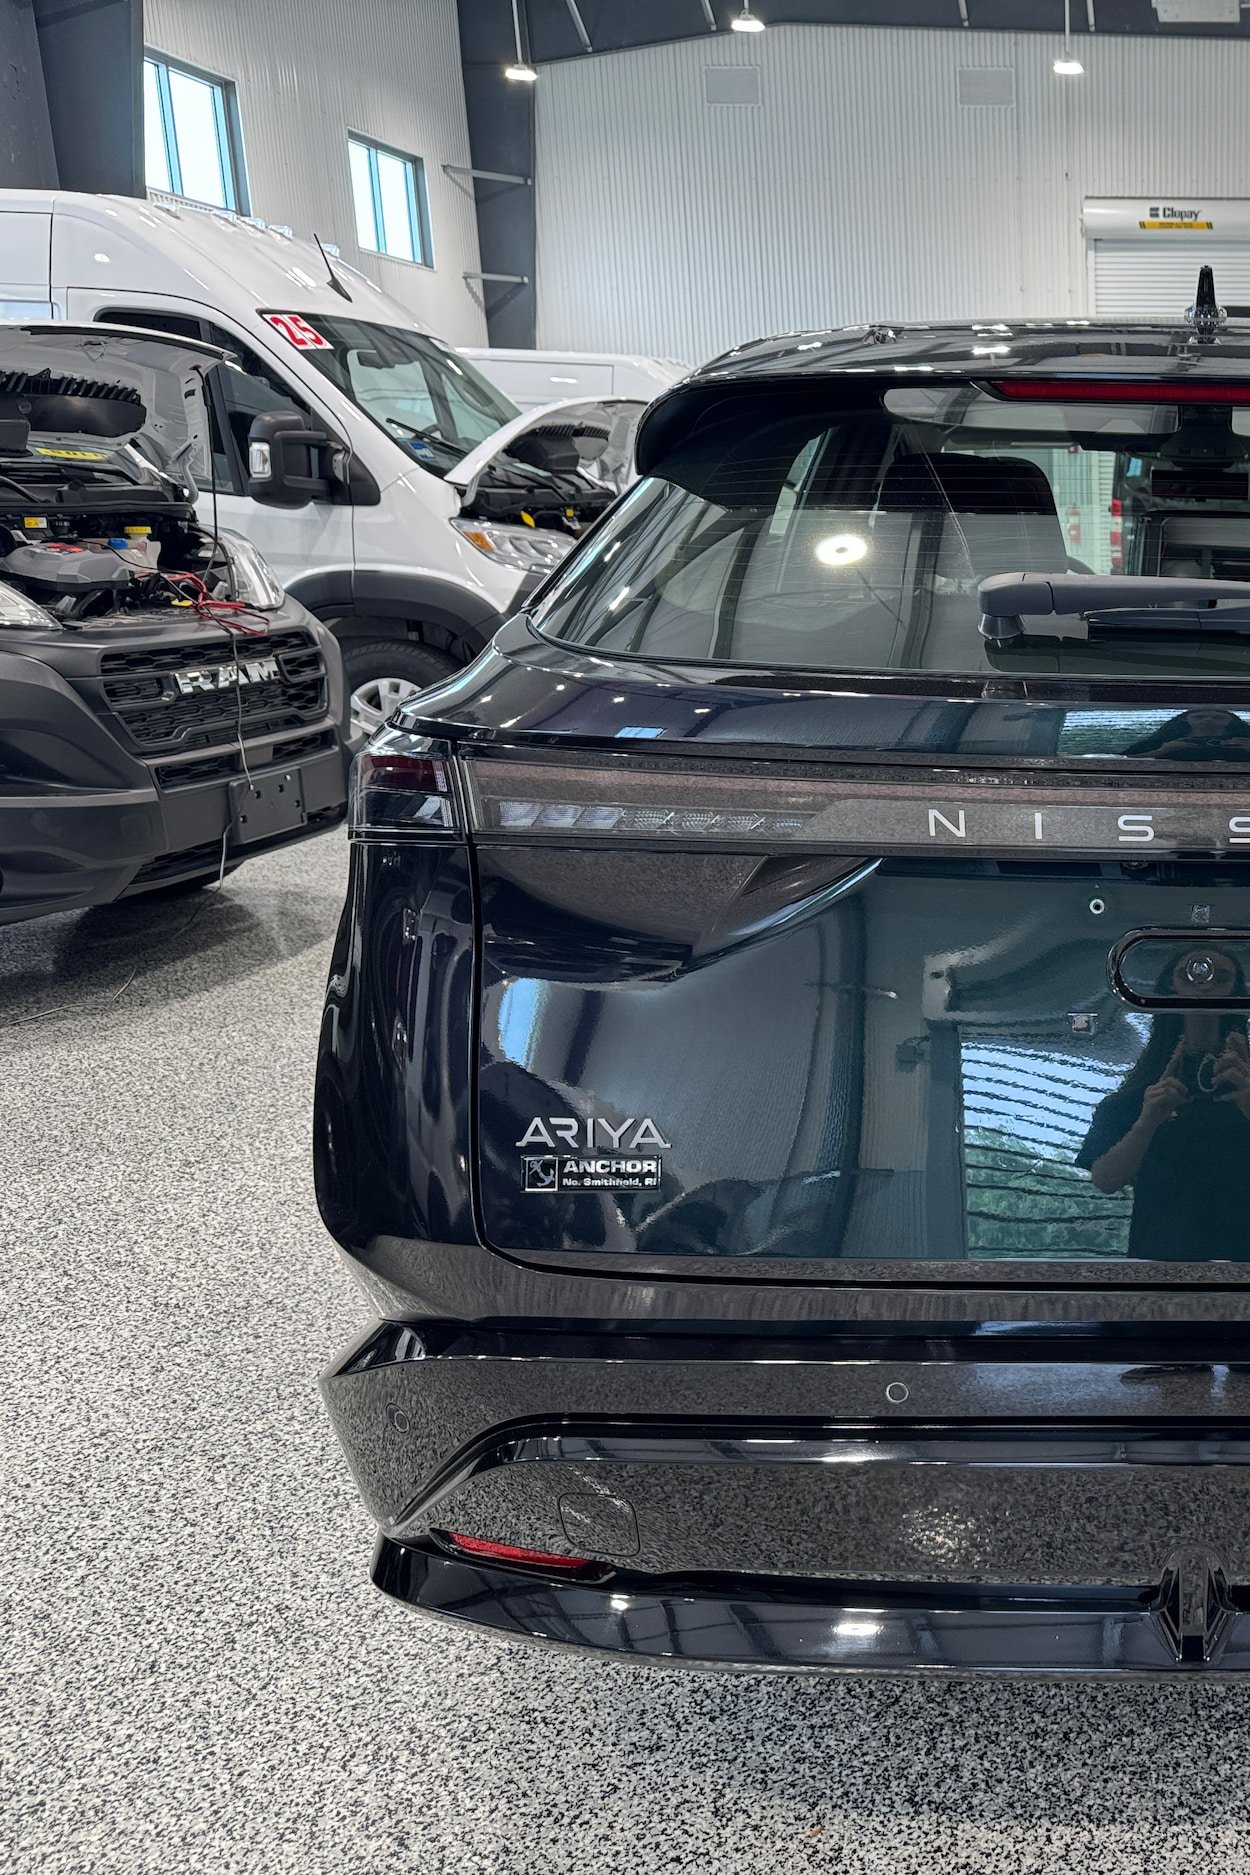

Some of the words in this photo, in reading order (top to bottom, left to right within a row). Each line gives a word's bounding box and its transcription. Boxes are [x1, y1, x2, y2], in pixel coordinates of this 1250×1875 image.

[1163, 207, 1200, 221] Clopay
[269, 316, 324, 346] 25
[175, 660, 279, 694] RAM
[515, 1117, 672, 1148] ARIYA
[563, 1160, 657, 1173] ANCHOR
[562, 1178, 581, 1186] No.
[644, 1178, 657, 1186] RI
